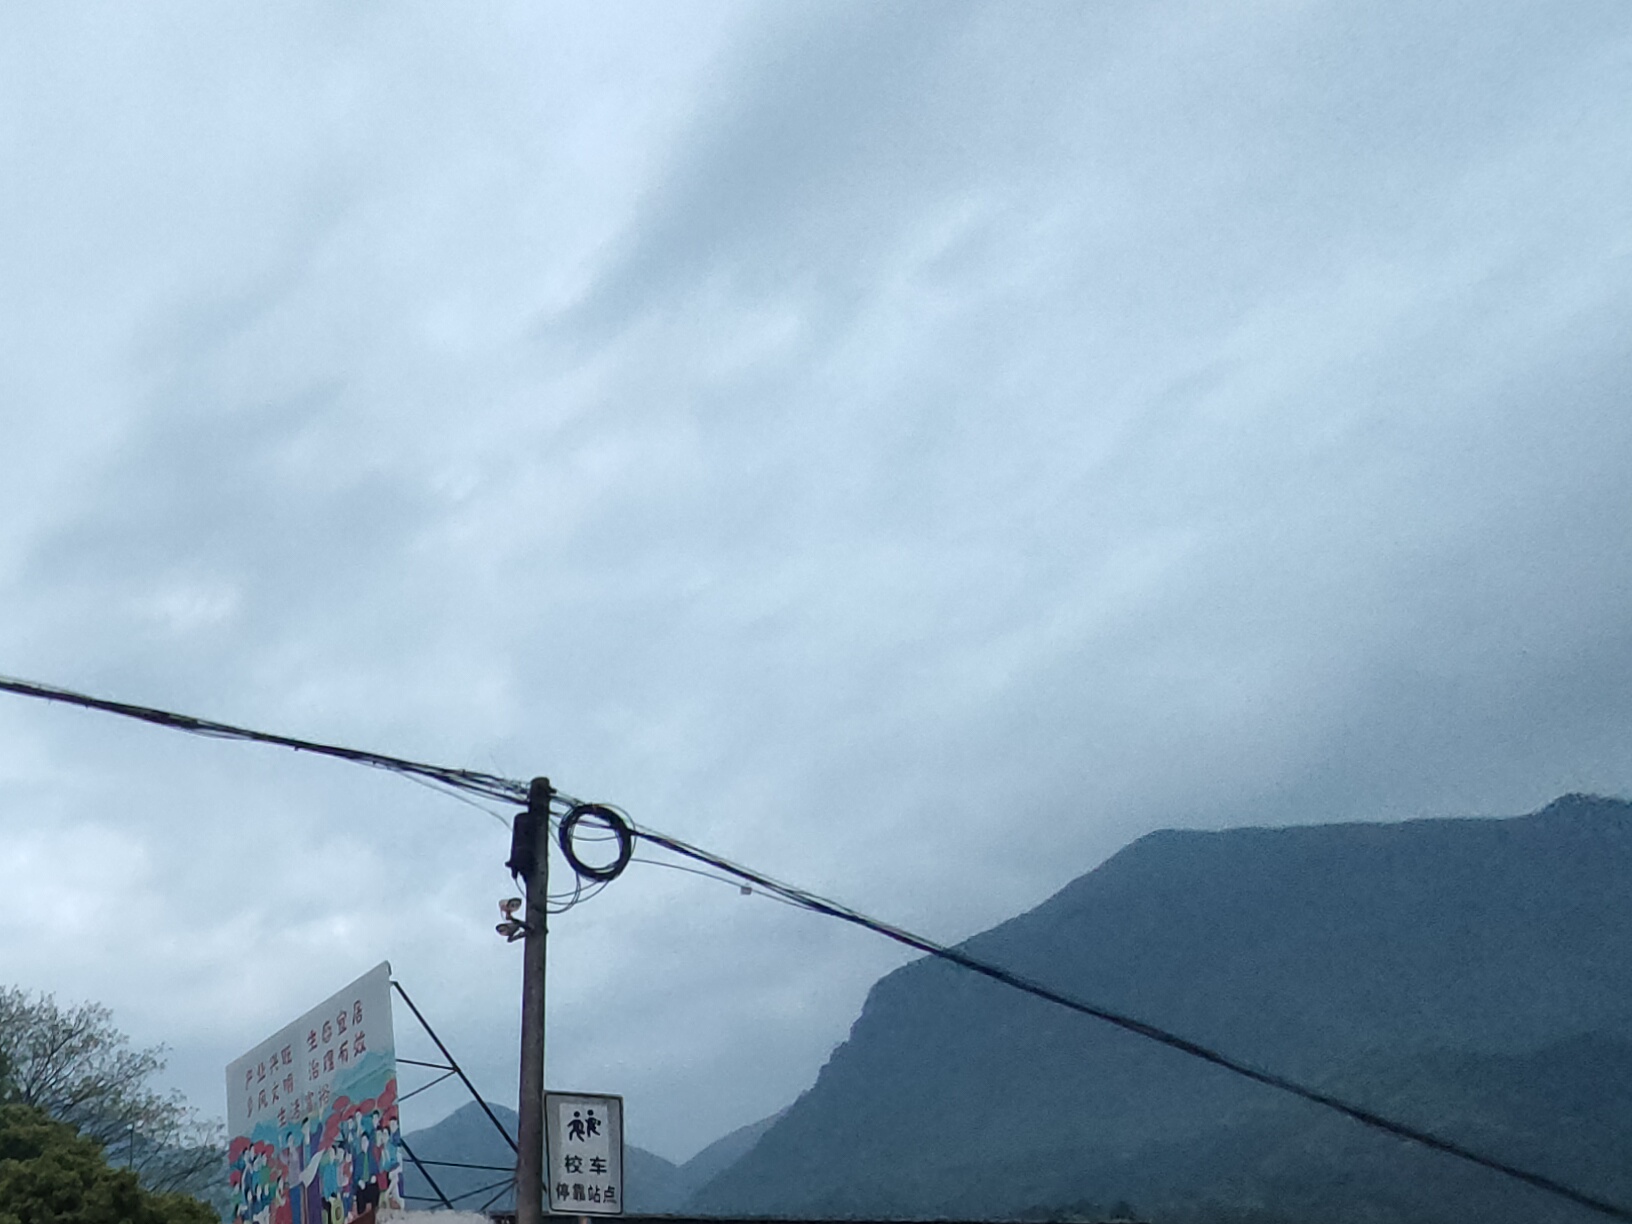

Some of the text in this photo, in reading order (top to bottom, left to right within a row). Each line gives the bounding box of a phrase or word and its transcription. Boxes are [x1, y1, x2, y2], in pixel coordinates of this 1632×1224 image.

[244, 999, 364, 1091] 产业兴旺 生态宜居
[246, 1030, 367, 1118] 乡风文明 治理有效
[276, 1083, 331, 1128] 生活富裕
[564, 1154, 608, 1175] 校车
[555, 1182, 618, 1205] 停靠站点
